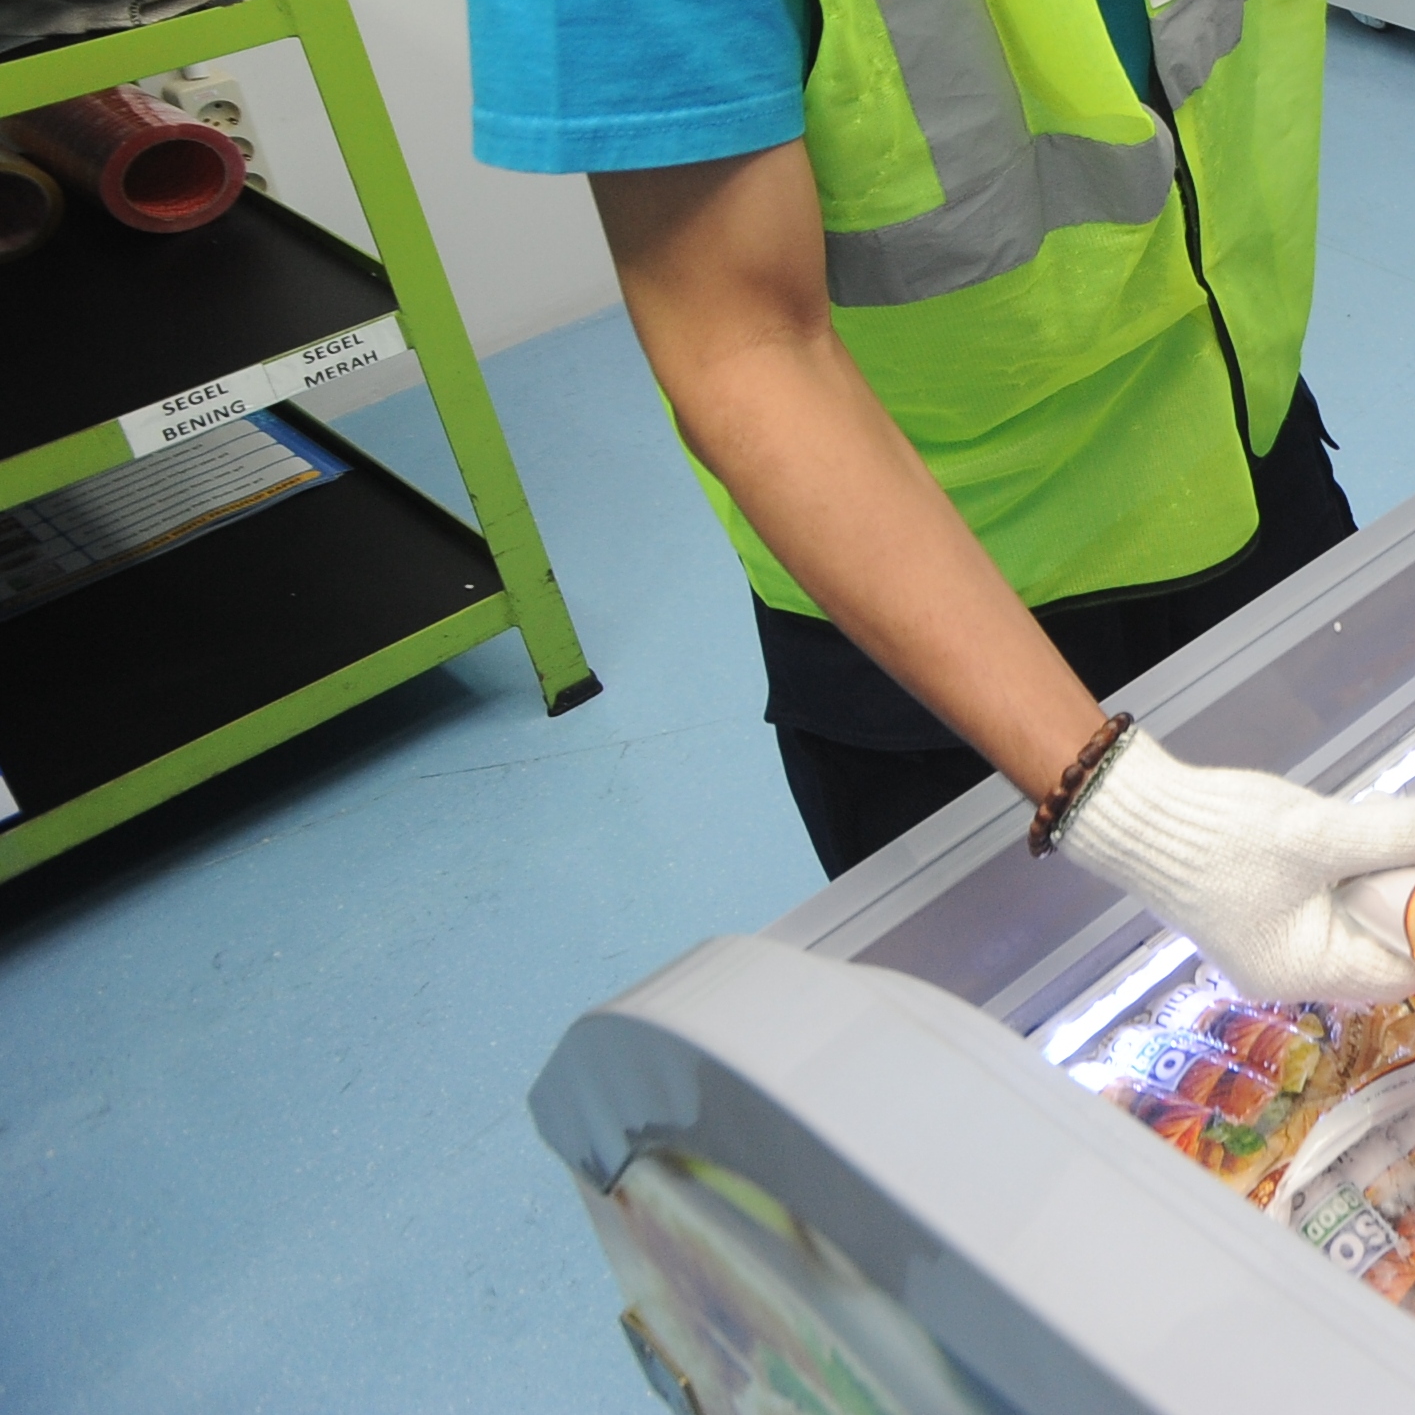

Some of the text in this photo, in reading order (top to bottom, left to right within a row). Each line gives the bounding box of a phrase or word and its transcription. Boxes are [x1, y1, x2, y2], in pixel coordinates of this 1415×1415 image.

[301, 332, 365, 365] SEGEL
[303, 350, 379, 388] MERAH
[162, 382, 229, 416] SEGEL
[162, 400, 247, 442] BENING
[1305, 1184, 1363, 1242] GOOD
[1329, 1214, 1393, 1272] SO
